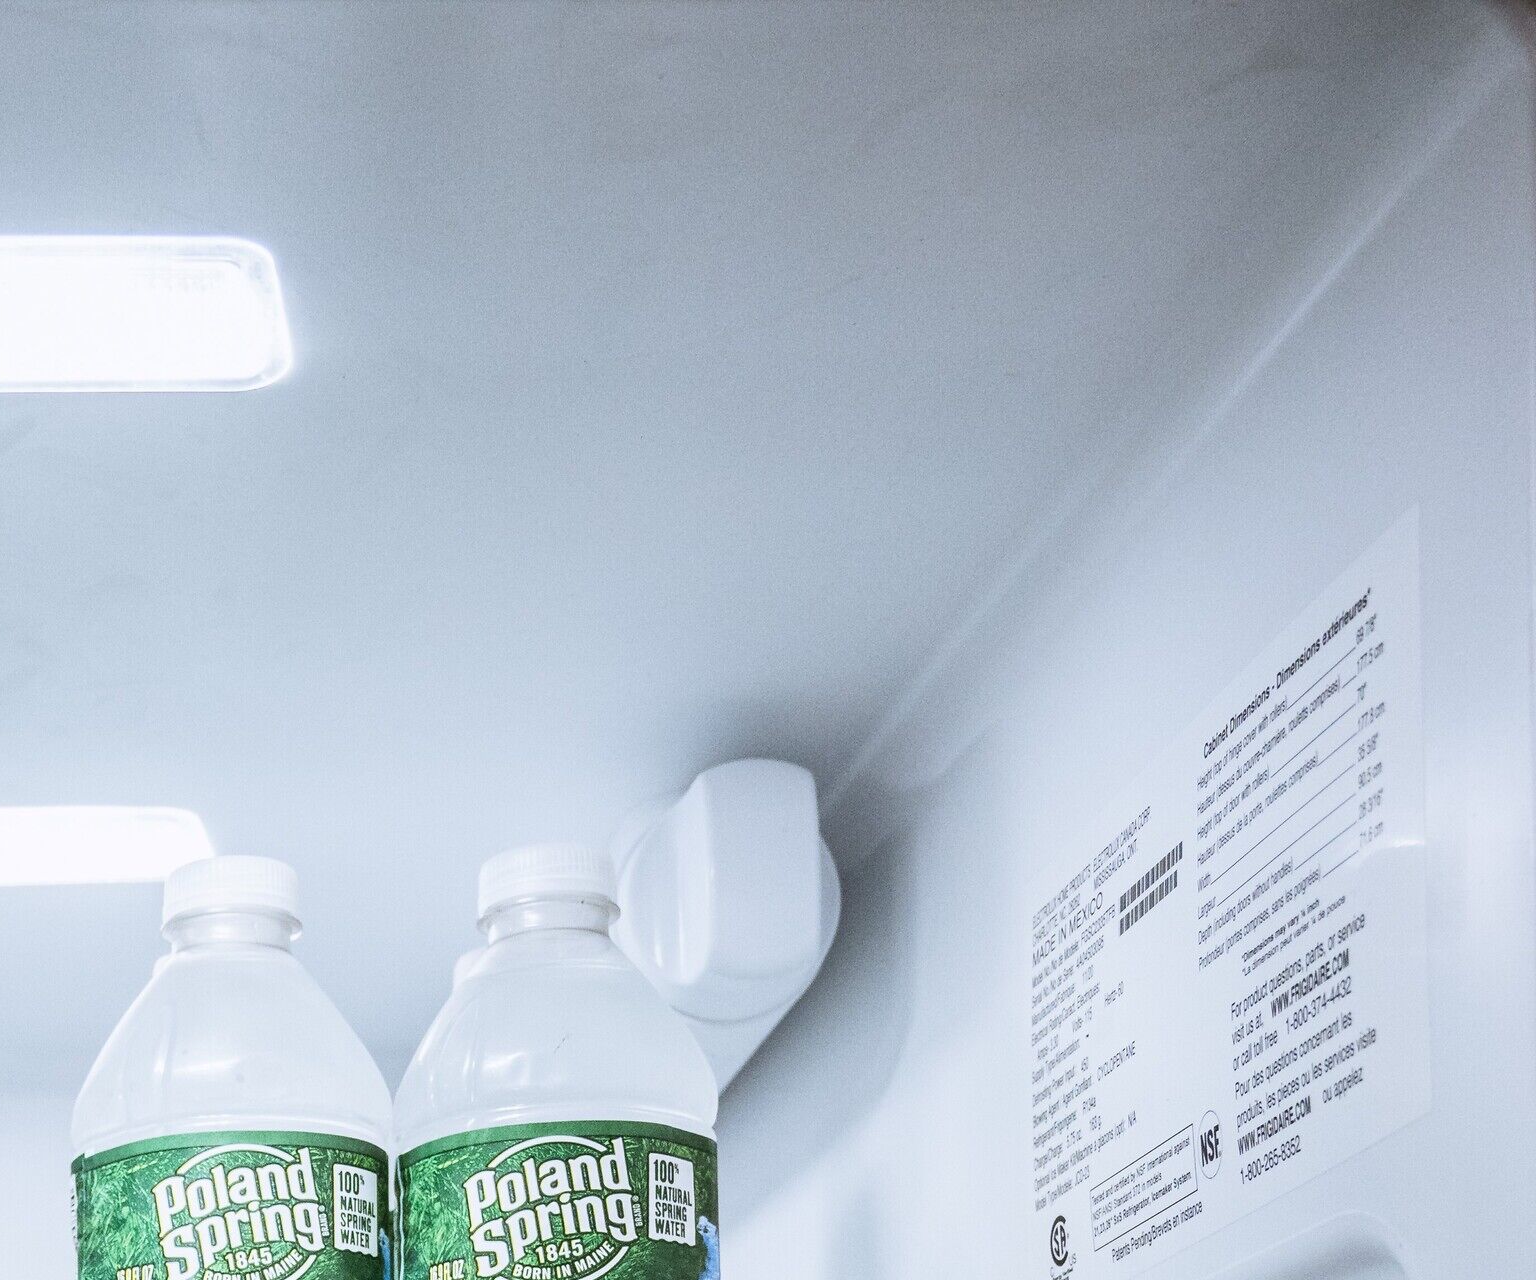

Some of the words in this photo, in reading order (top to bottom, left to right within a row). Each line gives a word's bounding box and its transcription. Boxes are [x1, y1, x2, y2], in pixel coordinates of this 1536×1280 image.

[1203, 721, 1227, 759] Cabinet
[1230, 681, 1269, 734] Dimensions
[1276, 633, 1319, 689] Dimensions
[1032, 932, 1055, 968] MADE
[1059, 922, 1066, 945] IN
[1069, 888, 1103, 936] MEXICO
[1231, 997, 1241, 1021] For
[1243, 980, 1266, 1017] product
[1328, 932, 1335, 951] or
[1338, 908, 1364, 945] service
[1245, 1018, 1253, 1037] us
[1270, 946, 1349, 1019] WWW.FRIGIDAIRE.COM
[1232, 1054, 1239, 1072] or
[1241, 1042, 1252, 1067] call
[1253, 1034, 1263, 1059] toll
[1264, 1024, 1277, 1051] free
[1285, 973, 1351, 1036] 1-800-374-4432
[1235, 1073, 1250, 1101] Pour
[1251, 1065, 1263, 1090] des
[1265, 1043, 1297, 1084] questions
[1340, 1005, 1351, 1032] les
[1266, 1088, 1275, 1111] les
[1301, 1067, 1310, 1088] ou
[1311, 1056, 1322, 1081] les
[1324, 1036, 1354, 1073] services
[1200, 1122, 1219, 1169] NSF
[1236, 1094, 1311, 1157] WWW.FRIGIDAIRE.COM
[463, 1137, 632, 1233] Poland
[1240, 1132, 1301, 1186] 1-800-265-8352
[151, 1147, 319, 1239] Poland
[340, 1195, 375, 1218] NATURAL
[340, 1213, 372, 1232] SPRING
[655, 1184, 693, 1207] NATURAL
[655, 1202, 688, 1222] SPRING
[226, 1248, 273, 1271] 1845
[340, 1228, 370, 1249] WATER
[470, 1193, 638, 1278] Spring
[535, 1239, 584, 1264] 1845
[655, 1218, 686, 1239] WATER
[1111, 1238, 1130, 1264] Patents
[1172, 1212, 1179, 1228] en
[1180, 1197, 1202, 1225] instance
[513, 1264, 551, 1280] BORN
[556, 1264, 572, 1279] IN
[575, 1241, 614, 1274] MAINE
